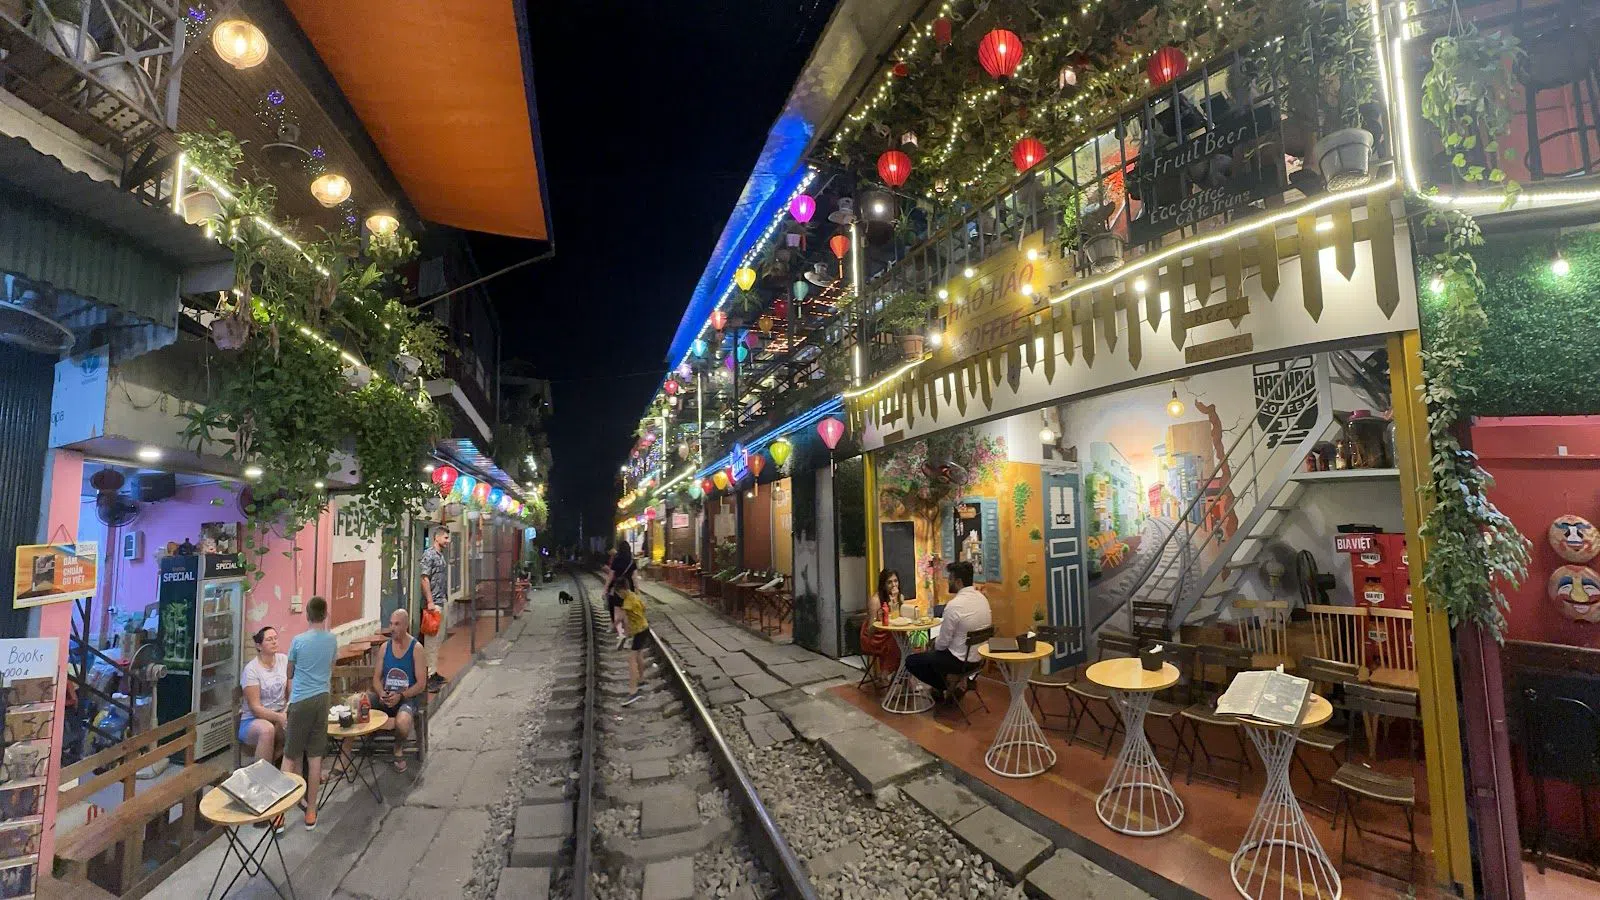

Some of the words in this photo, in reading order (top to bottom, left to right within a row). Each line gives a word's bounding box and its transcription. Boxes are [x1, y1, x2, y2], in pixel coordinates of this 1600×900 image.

[1153, 139, 1200, 178] Fruit
[1204, 126, 1247, 156] Beer
[1336, 538, 1353, 550] BIA
[215, 562, 238, 570] SPECIAL
[163, 571, 195, 583] SPECIAL
